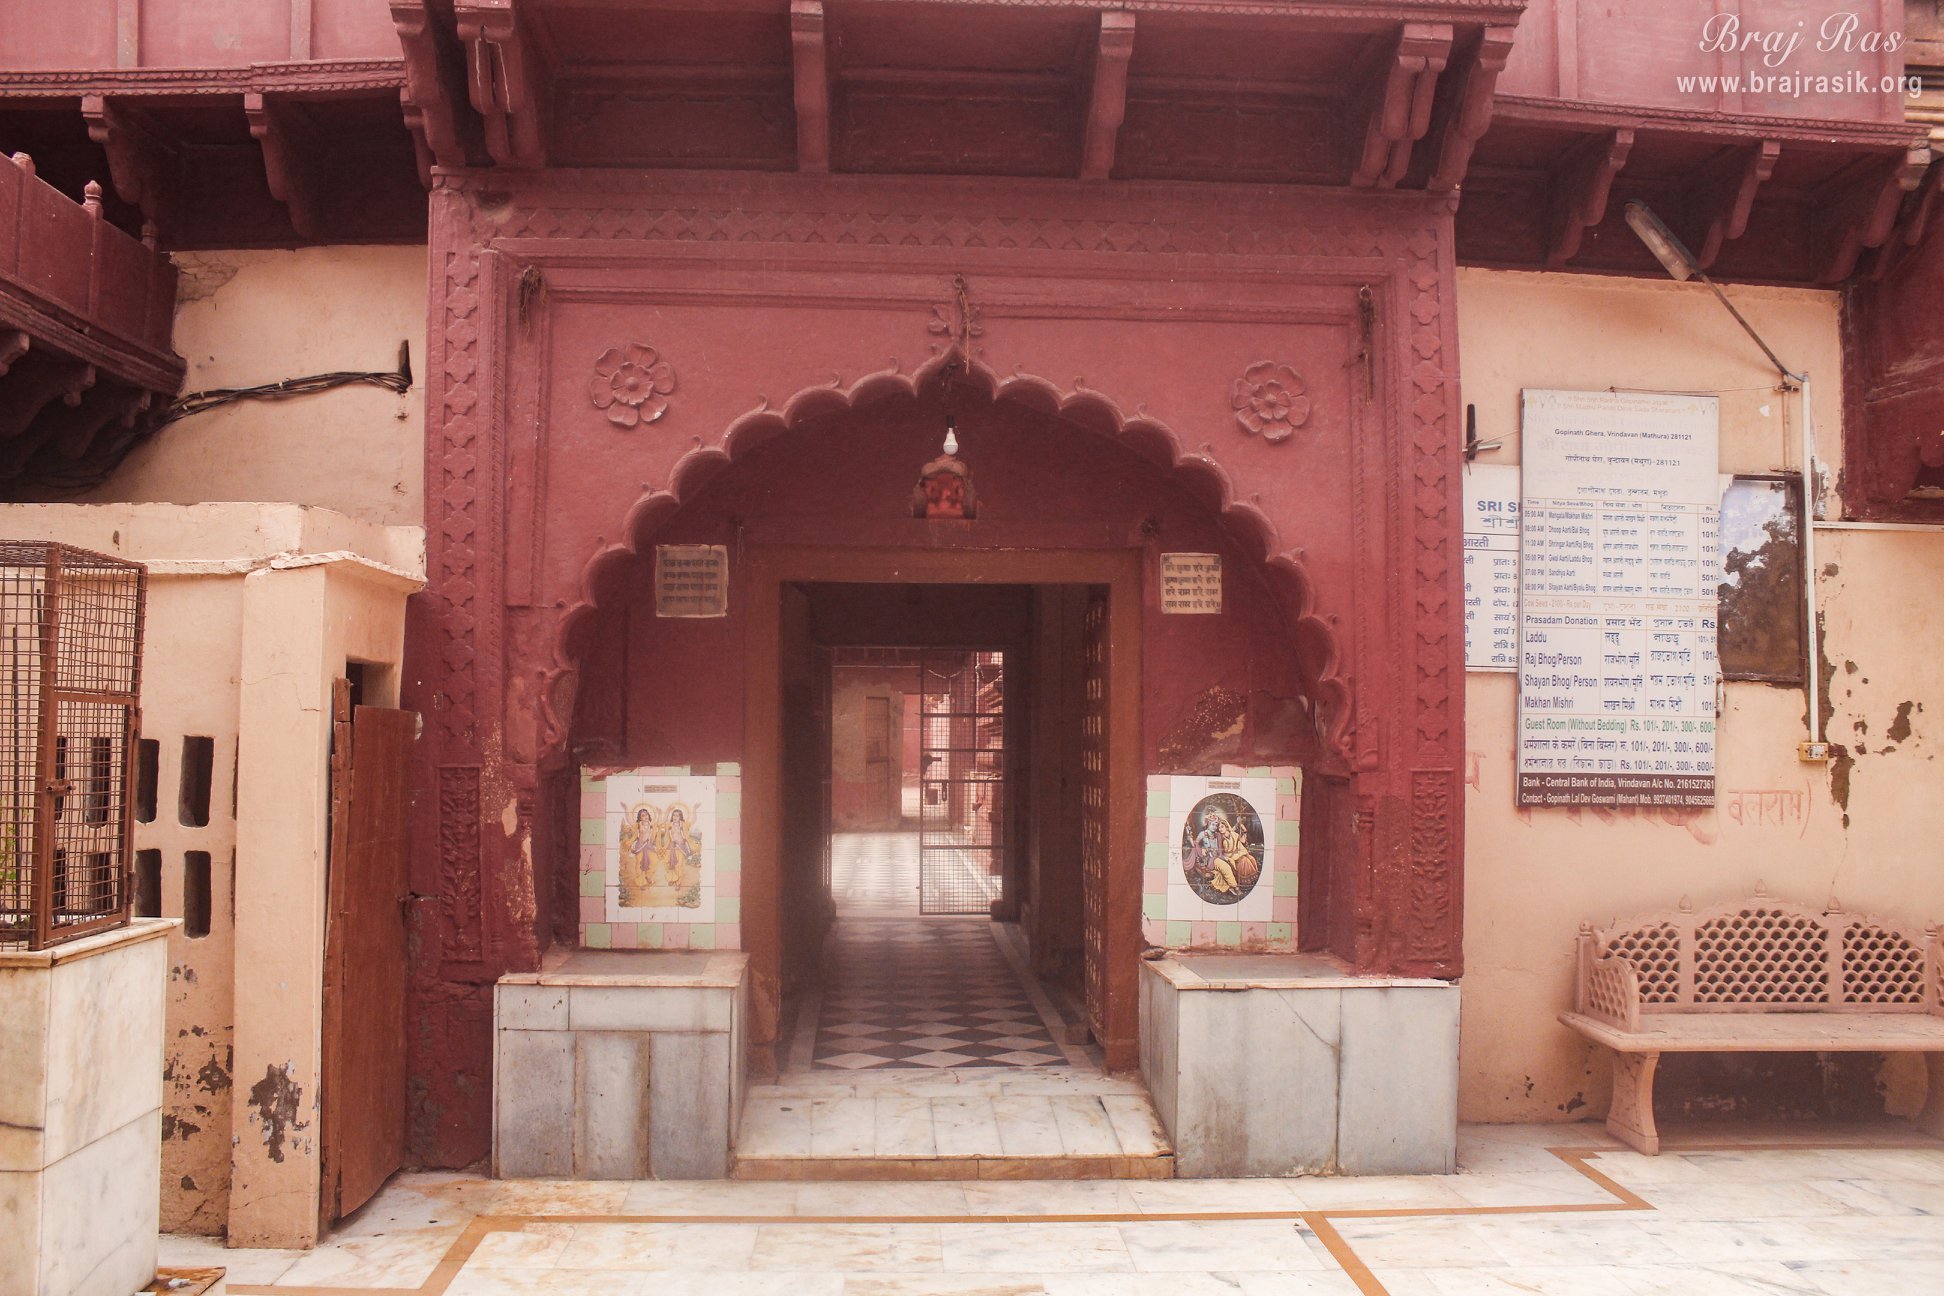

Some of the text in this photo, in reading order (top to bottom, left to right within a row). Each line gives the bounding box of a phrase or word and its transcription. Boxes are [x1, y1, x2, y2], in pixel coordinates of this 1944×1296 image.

[1640, 432, 1669, 440] (Mathura)
[1477, 501, 1520, 513] SRI S
[1526, 615, 1598, 625] Prasadam Donation
[1605, 618, 1625, 626] प्रसाद
[1702, 620, 1718, 628] Rs.
[1526, 631, 1547, 643] Laddu
[1525, 653, 1536, 667] Raj
[1525, 674, 1550, 689] Shayan
[1574, 675, 1597, 687] Person
[1525, 696, 1573, 708] Makhan Mishri
[1525, 718, 1544, 730] Guest
[1547, 718, 1566, 729] Room
[1568, 718, 1596, 732] (Without
[1597, 719, 1627, 733] Bedding)
[1631, 720, 1640, 731] Rs.
[1700, 721, 1715, 733] 600/-
[1552, 736, 1559, 749] के
[1695, 742, 1713, 753] 600/-
[1620, 760, 1632, 769] Rs.
[1697, 761, 1714, 771] 600/-
[1523, 777, 1540, 787] Bank
[1546, 777, 1570, 787] Central
[1571, 777, 1588, 787] Bank
[1590, 778, 1597, 787] of
[1598, 777, 1616, 789] India,
[1618, 778, 1650, 788] Vrindavan
[1651, 778, 1663, 788] A/c
[1664, 778, 1675, 788] No.
[1522, 793, 1542, 803] Contact
[1546, 793, 1571, 804] Gopinath
[1571, 793, 1579, 803] Lal
[1580, 793, 1590, 803] Dev
[1592, 793, 1615, 803] Goswami
